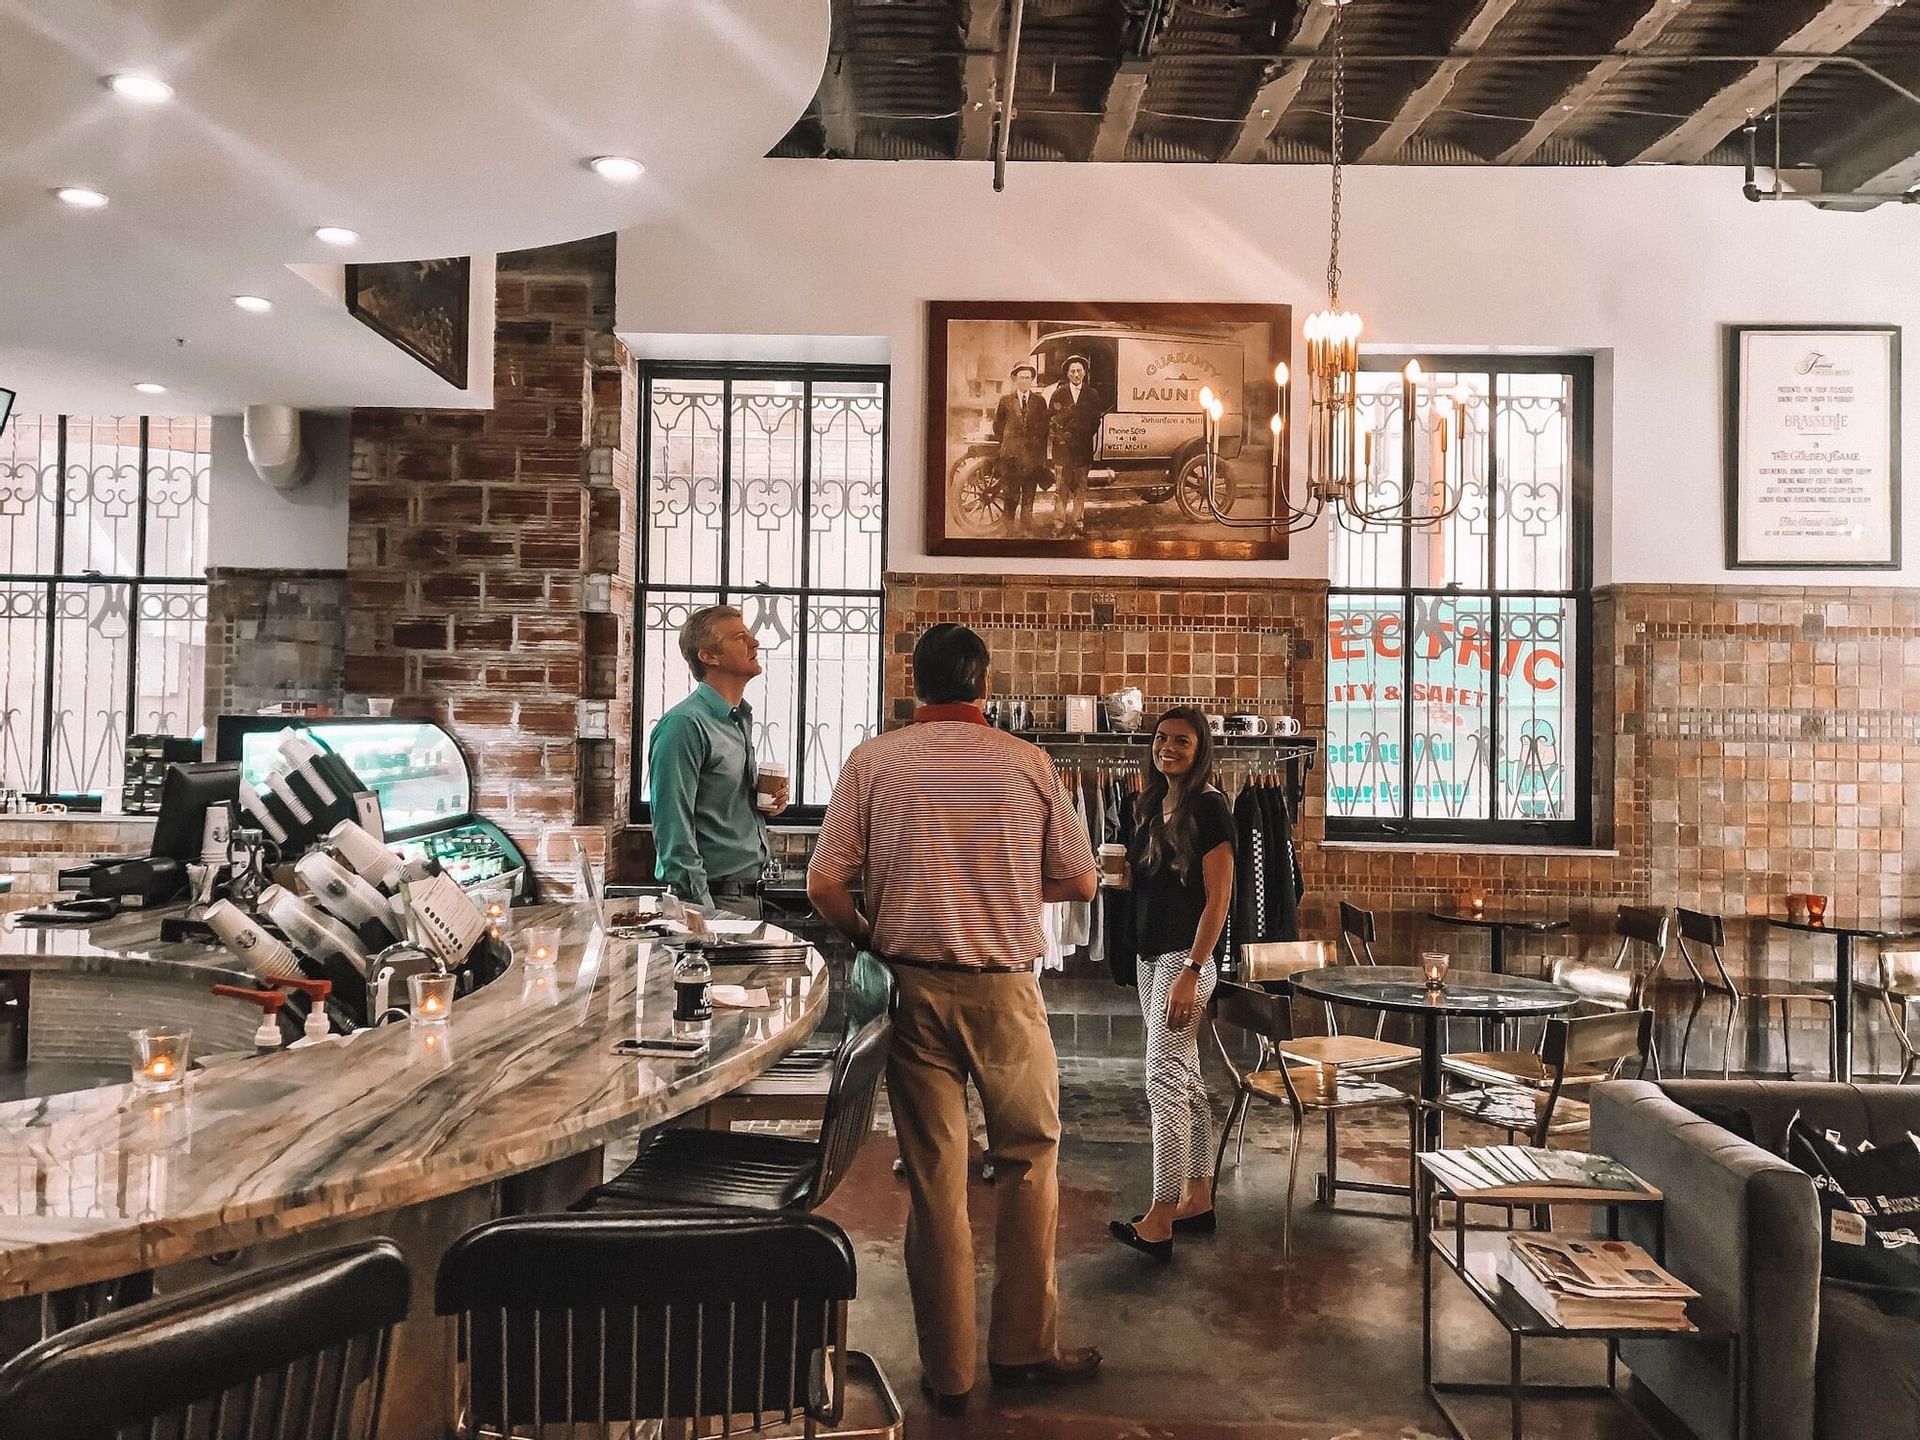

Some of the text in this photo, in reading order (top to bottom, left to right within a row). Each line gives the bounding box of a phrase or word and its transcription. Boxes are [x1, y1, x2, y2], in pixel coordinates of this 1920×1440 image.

[1132, 387, 1230, 402] LAUN
[1784, 412, 1849, 431] BRASSERIE
[1108, 426, 1130, 435] Phone
[1383, 685, 1400, 701] &
